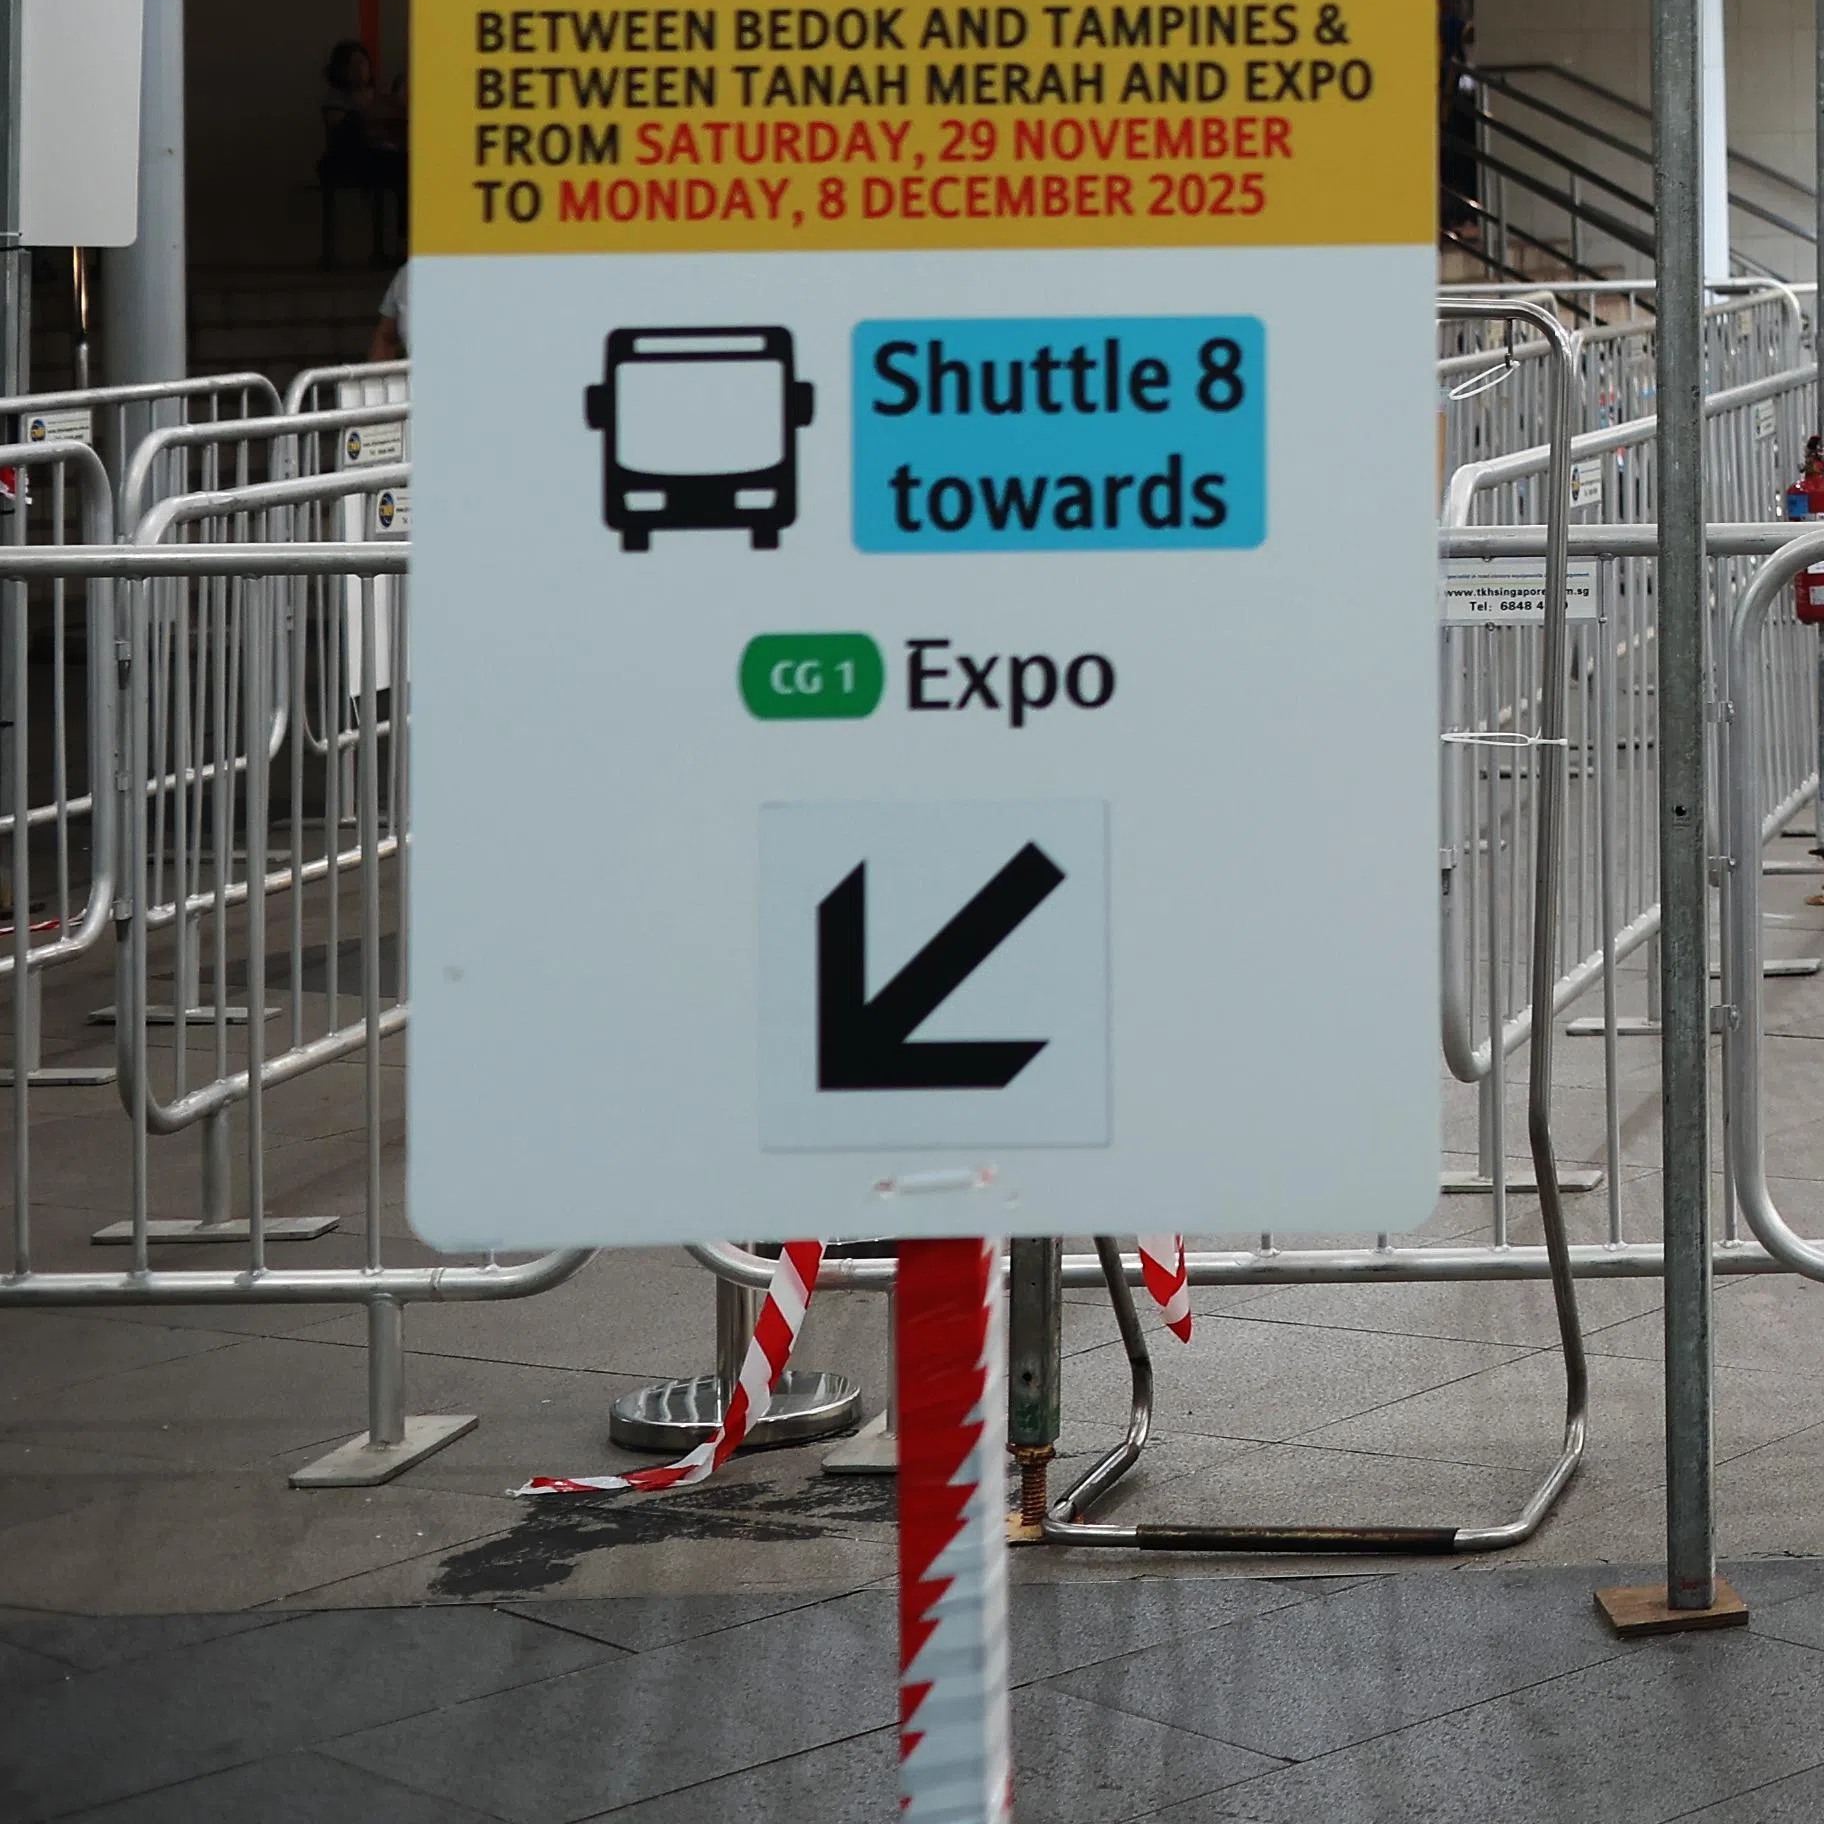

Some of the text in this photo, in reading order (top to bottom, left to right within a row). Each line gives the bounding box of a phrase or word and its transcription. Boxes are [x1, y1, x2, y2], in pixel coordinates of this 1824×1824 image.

[872, 336, 1245, 417] Shuttle 8
[887, 452, 1228, 534] towards
[769, 638, 1116, 729] CG 1 Expo
